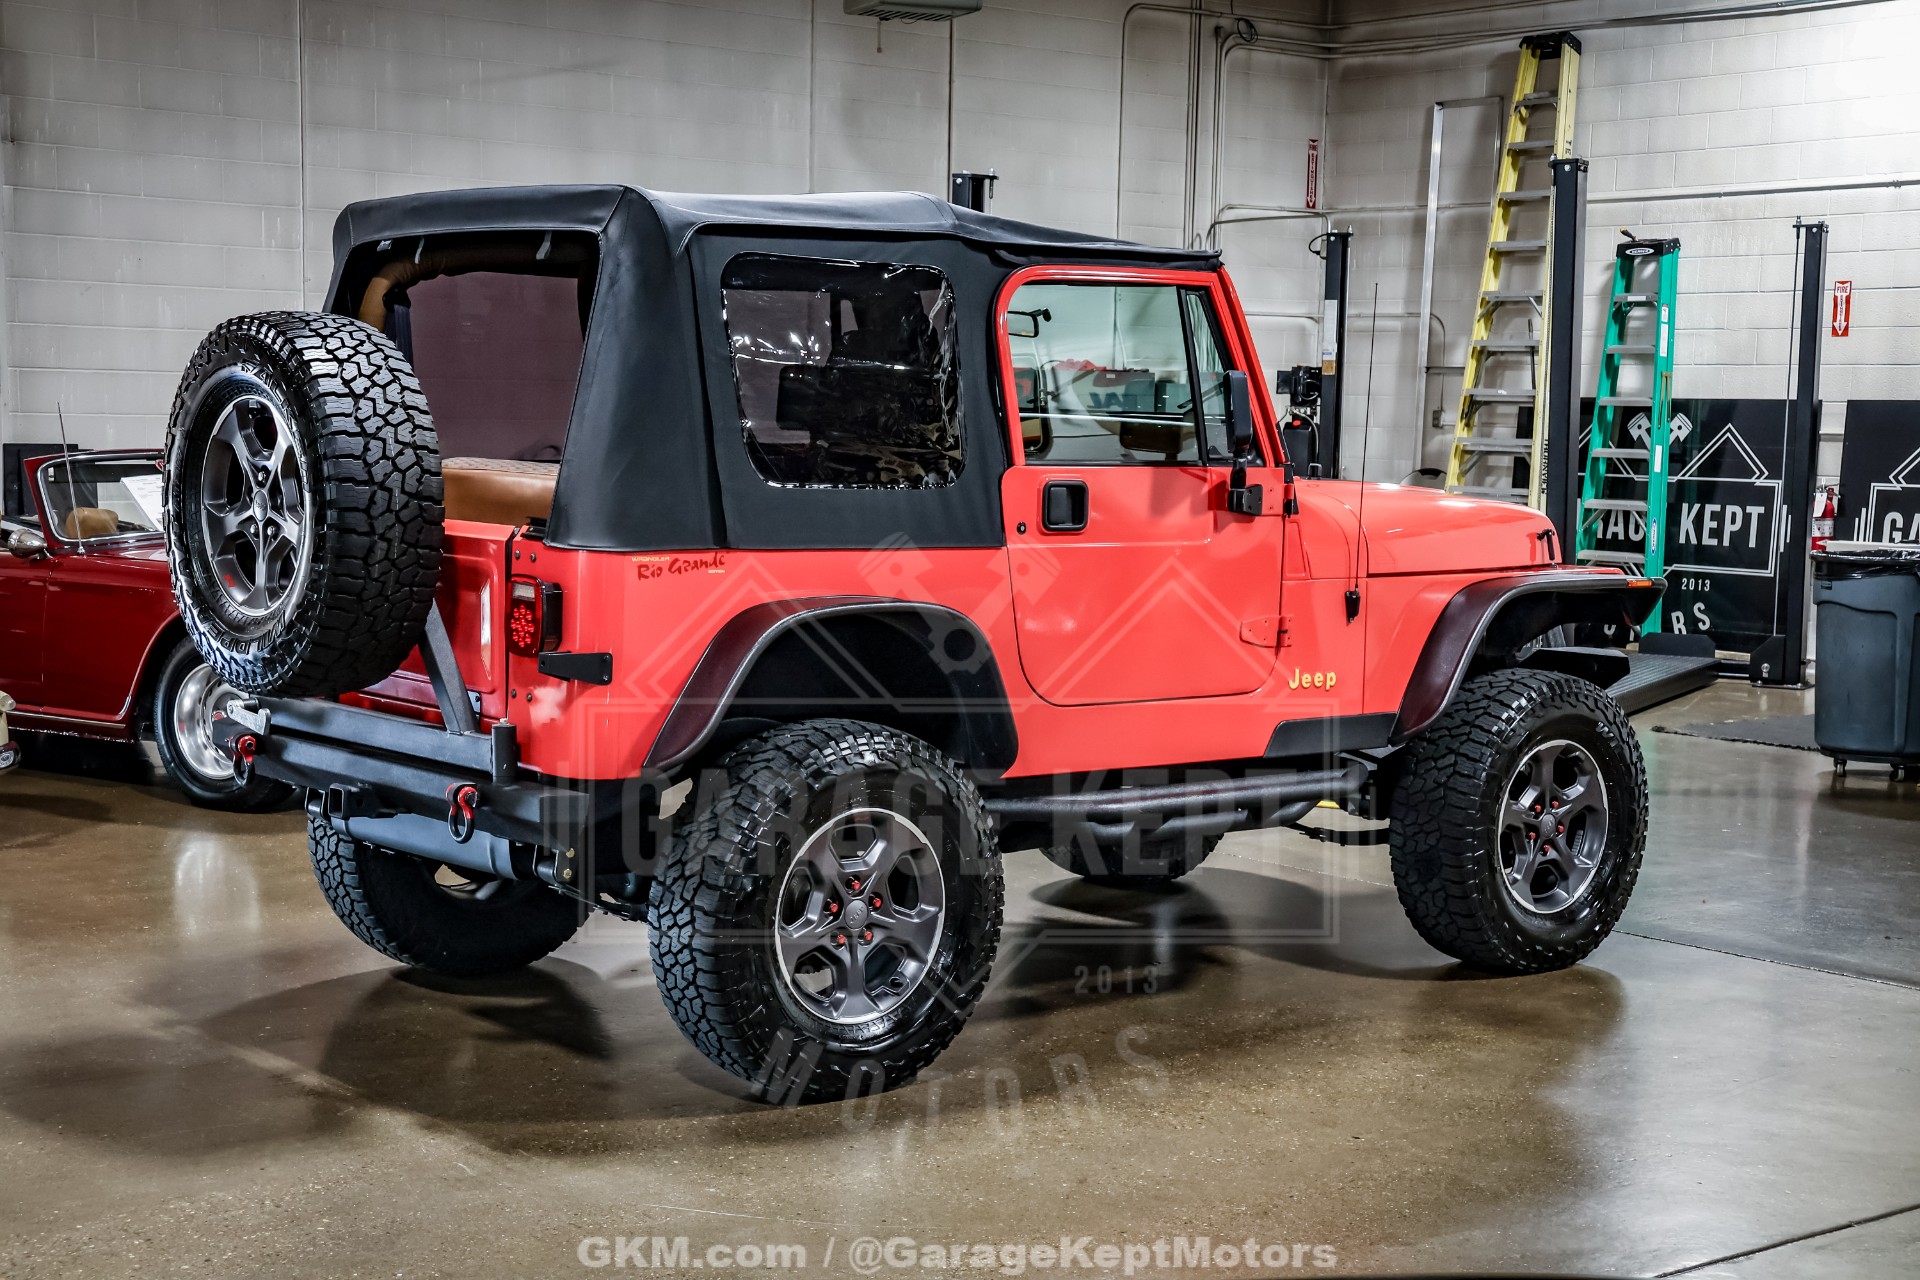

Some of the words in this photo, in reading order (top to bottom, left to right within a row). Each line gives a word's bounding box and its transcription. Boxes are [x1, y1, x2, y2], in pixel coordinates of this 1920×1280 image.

[1836, 285, 1849, 294] FIRE
[1679, 503, 1765, 548] KEPT
[637, 564, 663, 581] Rio
[668, 551, 726, 575] Grande
[1681, 577, 1711, 592] 2013
[1288, 667, 1337, 692] Jeep
